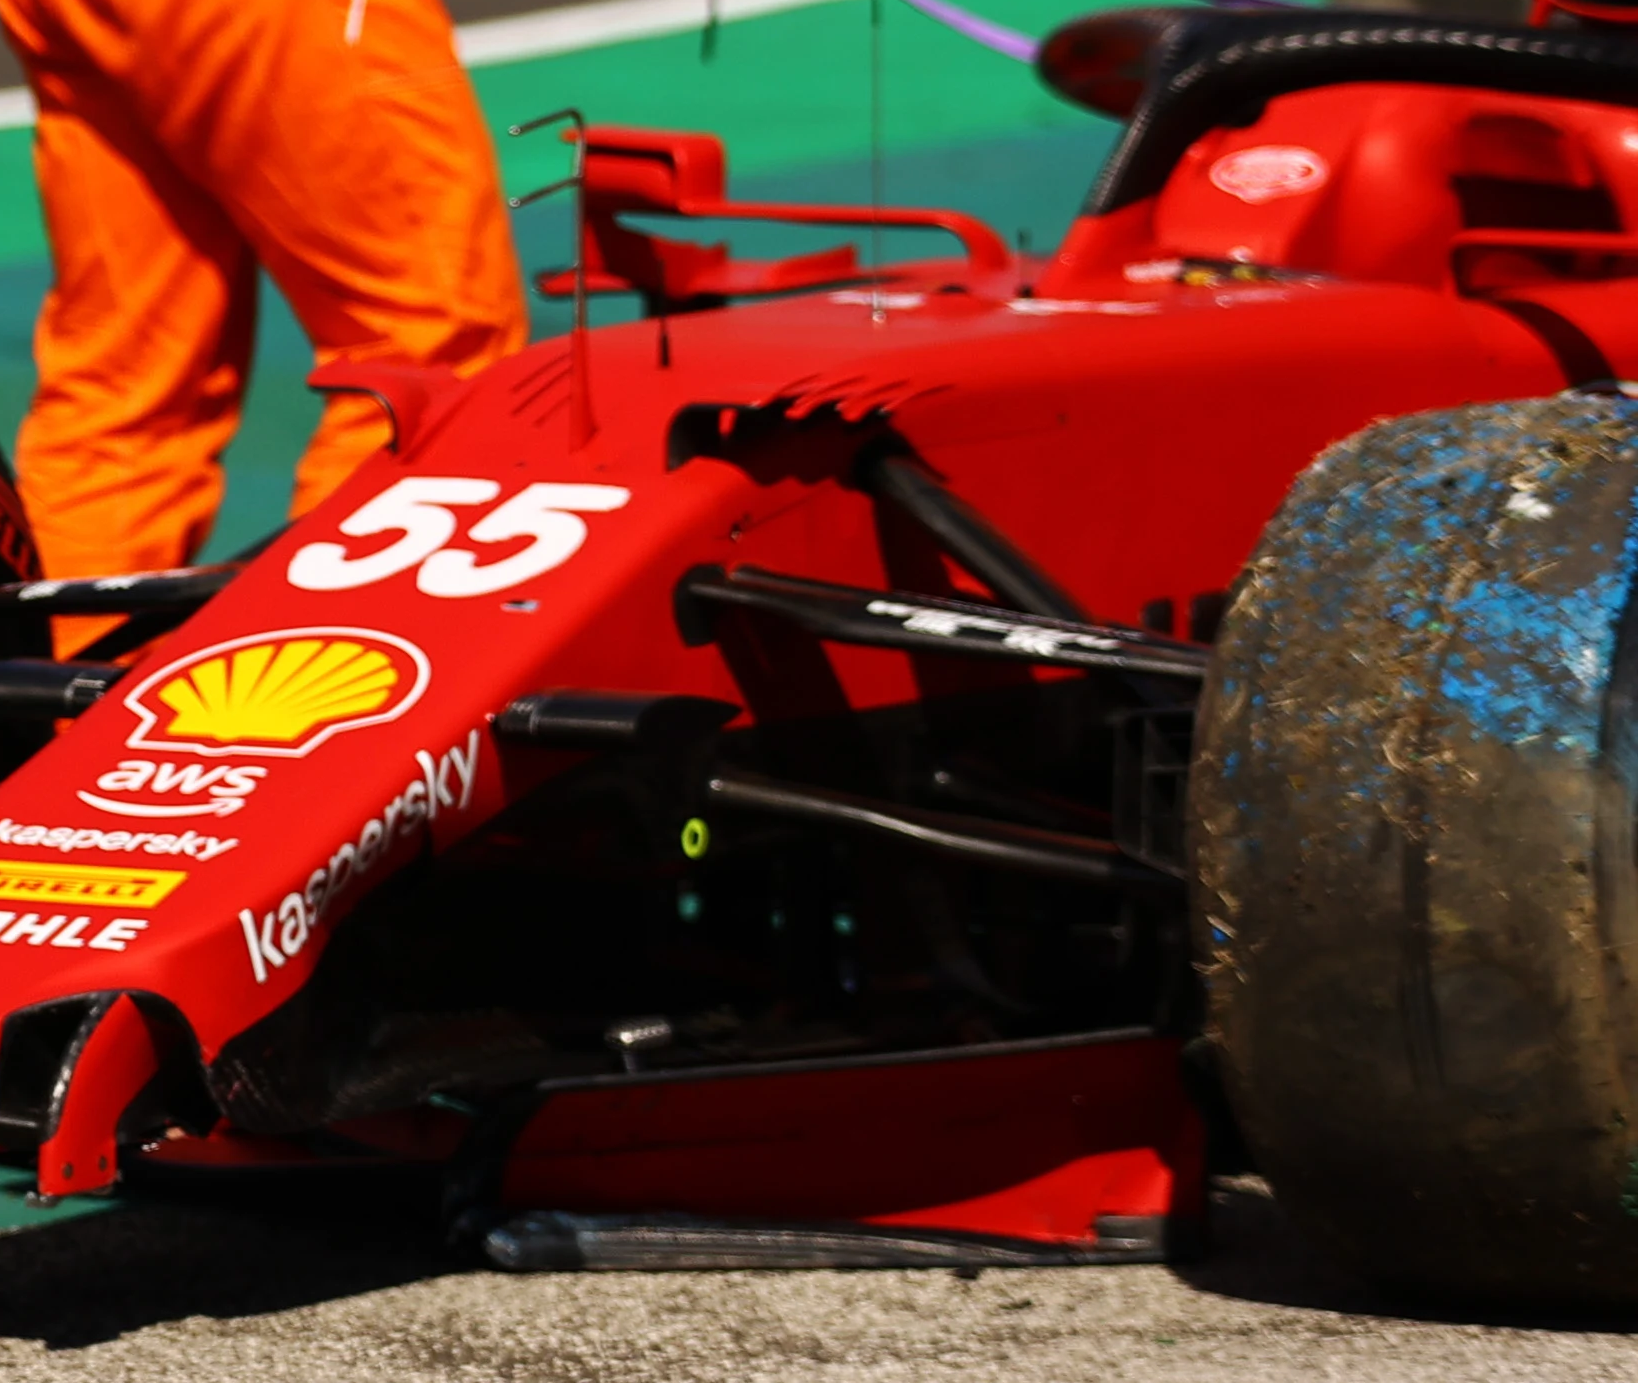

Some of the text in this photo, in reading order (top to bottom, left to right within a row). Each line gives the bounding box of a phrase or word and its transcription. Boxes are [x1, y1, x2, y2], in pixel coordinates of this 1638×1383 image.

[287, 476, 631, 598] 55
[96, 759, 268, 798] aws
[238, 728, 480, 984] kaspersky
